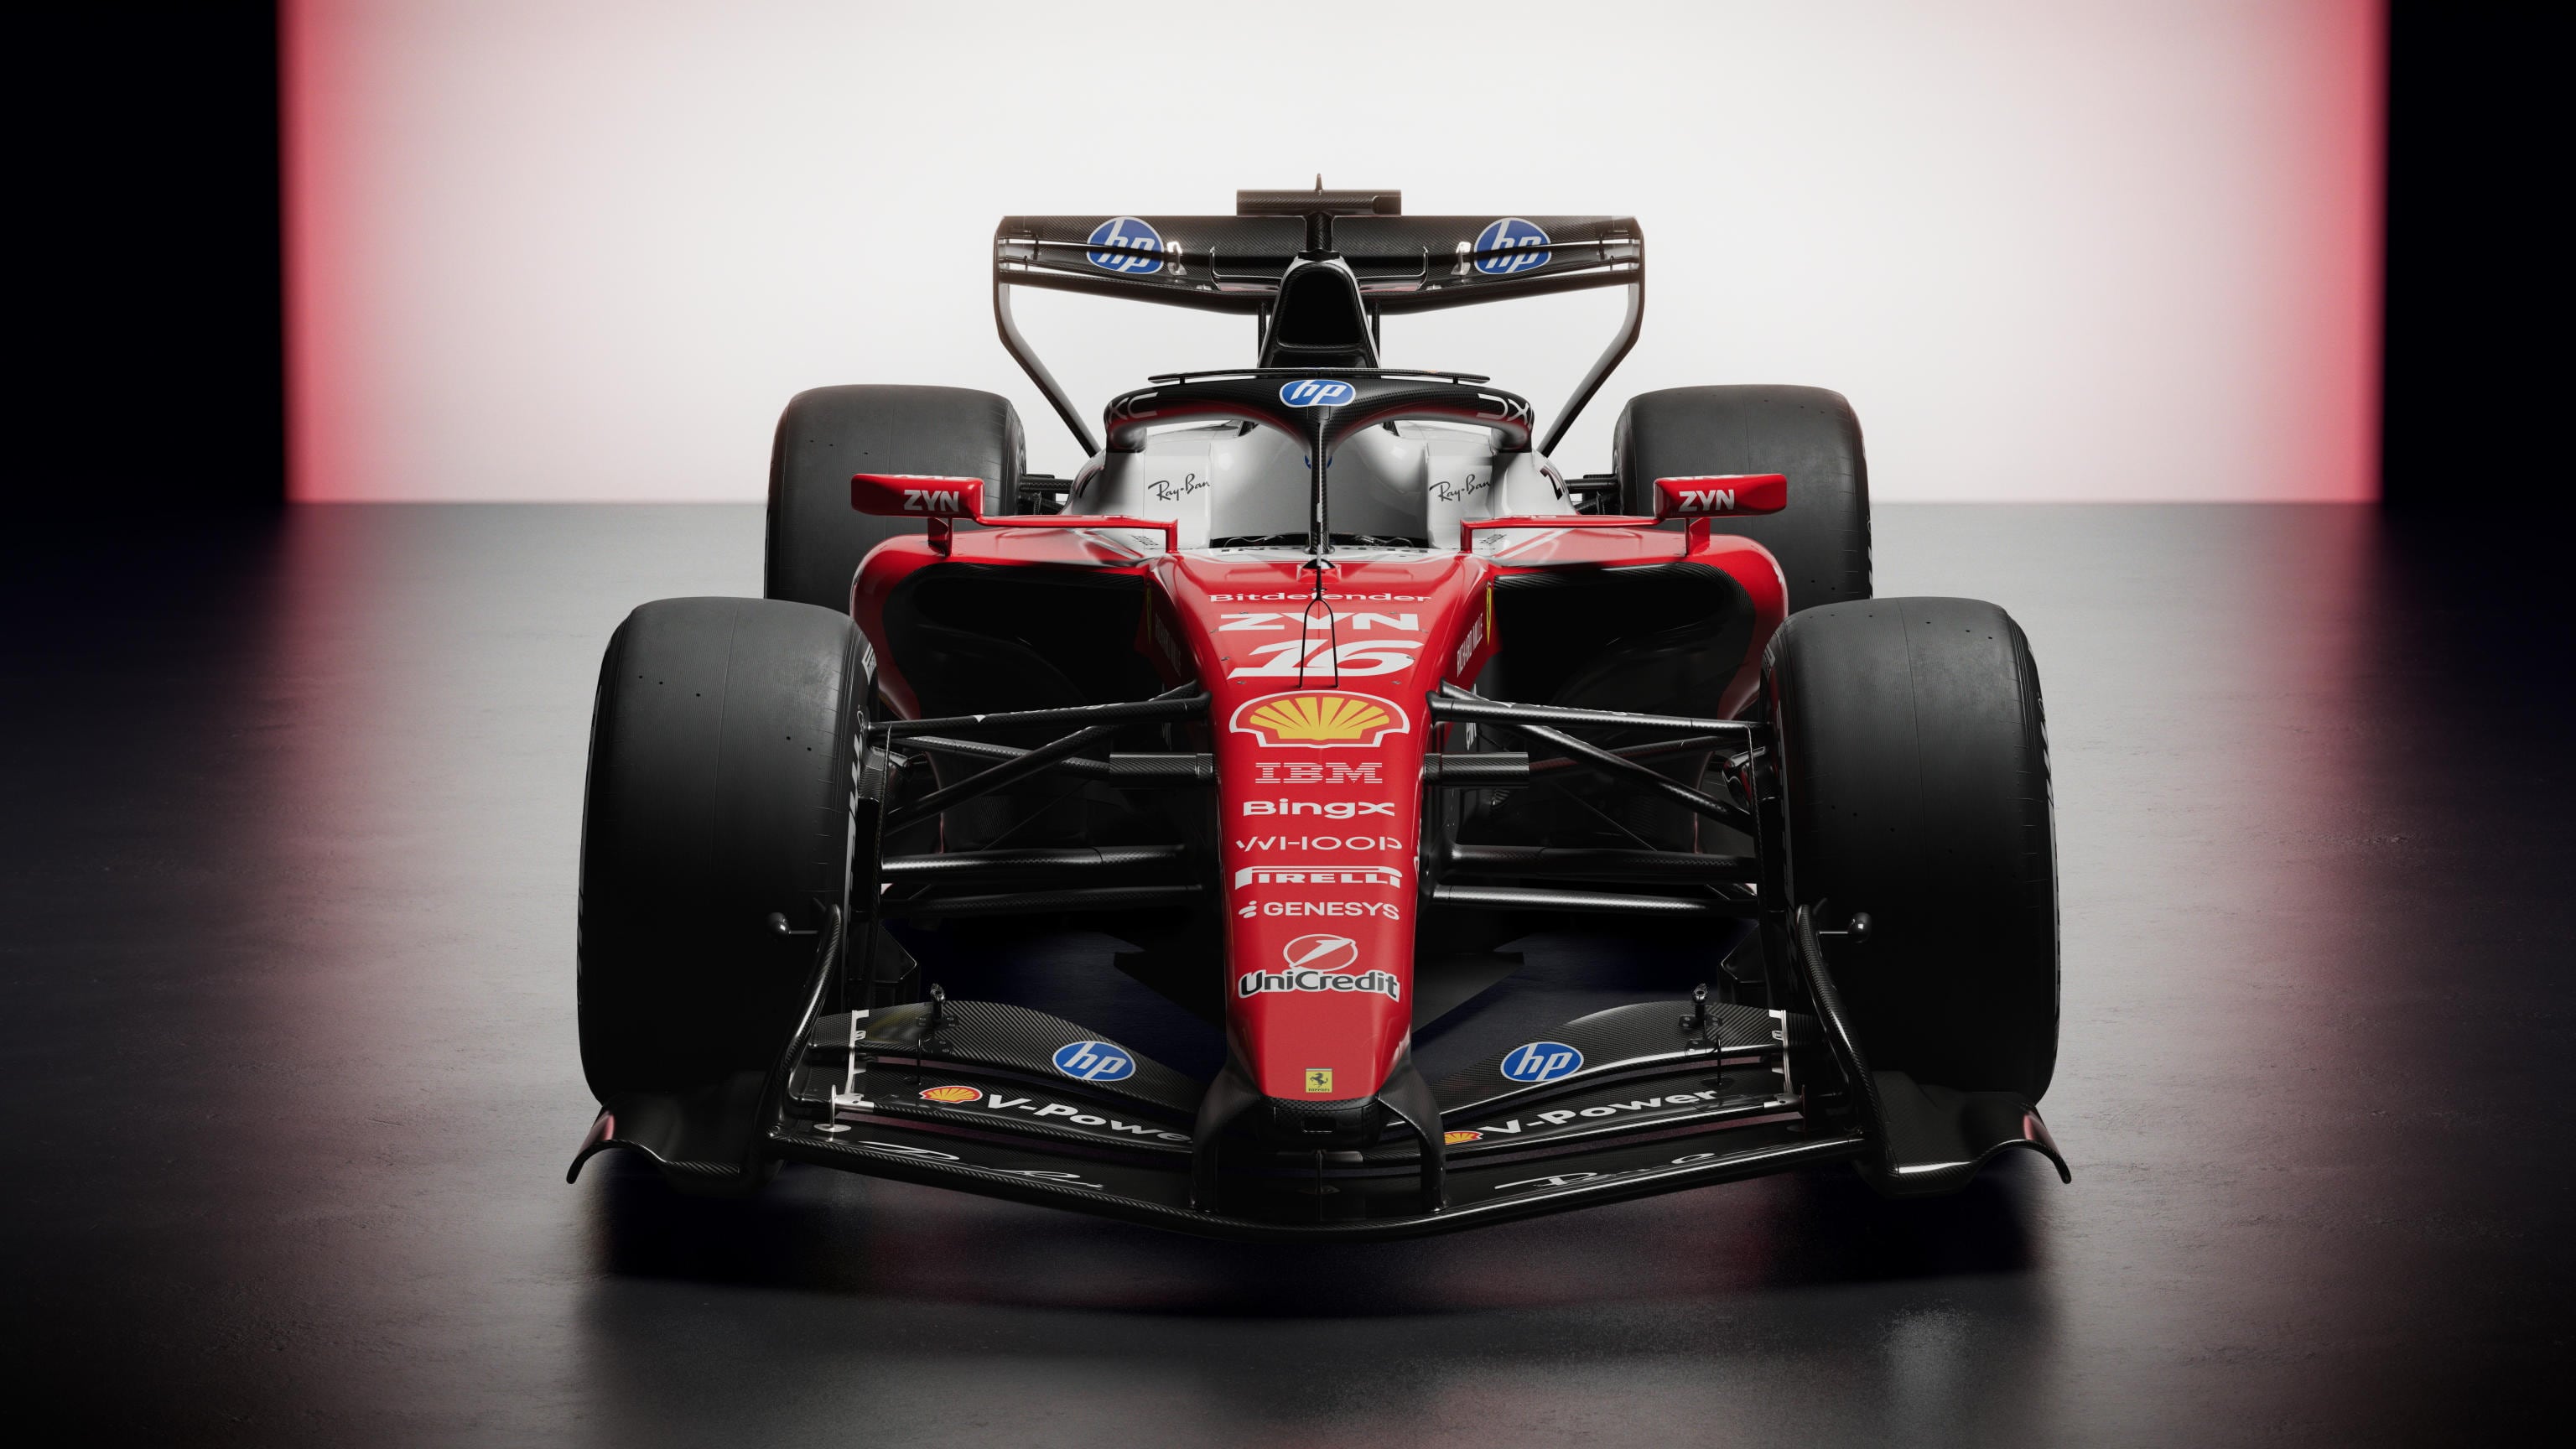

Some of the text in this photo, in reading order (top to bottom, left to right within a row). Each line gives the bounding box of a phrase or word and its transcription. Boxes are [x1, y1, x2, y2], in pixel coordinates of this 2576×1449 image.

[1095, 218, 1157, 273] hp
[1484, 219, 1544, 273] hp
[1290, 380, 1348, 406] hp
[1102, 391, 1159, 429] XC
[1475, 392, 1533, 430] DX
[903, 489, 959, 512] ZYN
[1147, 473, 1211, 501] Ray-Ban
[1429, 474, 1492, 502] Ray-Ban
[1678, 489, 1735, 512] ZYN
[1207, 592, 1432, 603] Bitdefender
[1218, 612, 1420, 631] ZYN
[1226, 638, 1425, 680] 16
[1254, 761, 1384, 784] IBM
[1235, 836, 1403, 853] WHOOP
[1234, 865, 1403, 891] PIRELLI
[1263, 901, 1400, 921] GENESYS
[1239, 969, 1400, 1002] UniCredit
[1062, 1041, 1127, 1081] hp
[1513, 1042, 1573, 1082] hp
[987, 1093, 1194, 1144] V-Powe
[1476, 1090, 1717, 1134] V-Power
